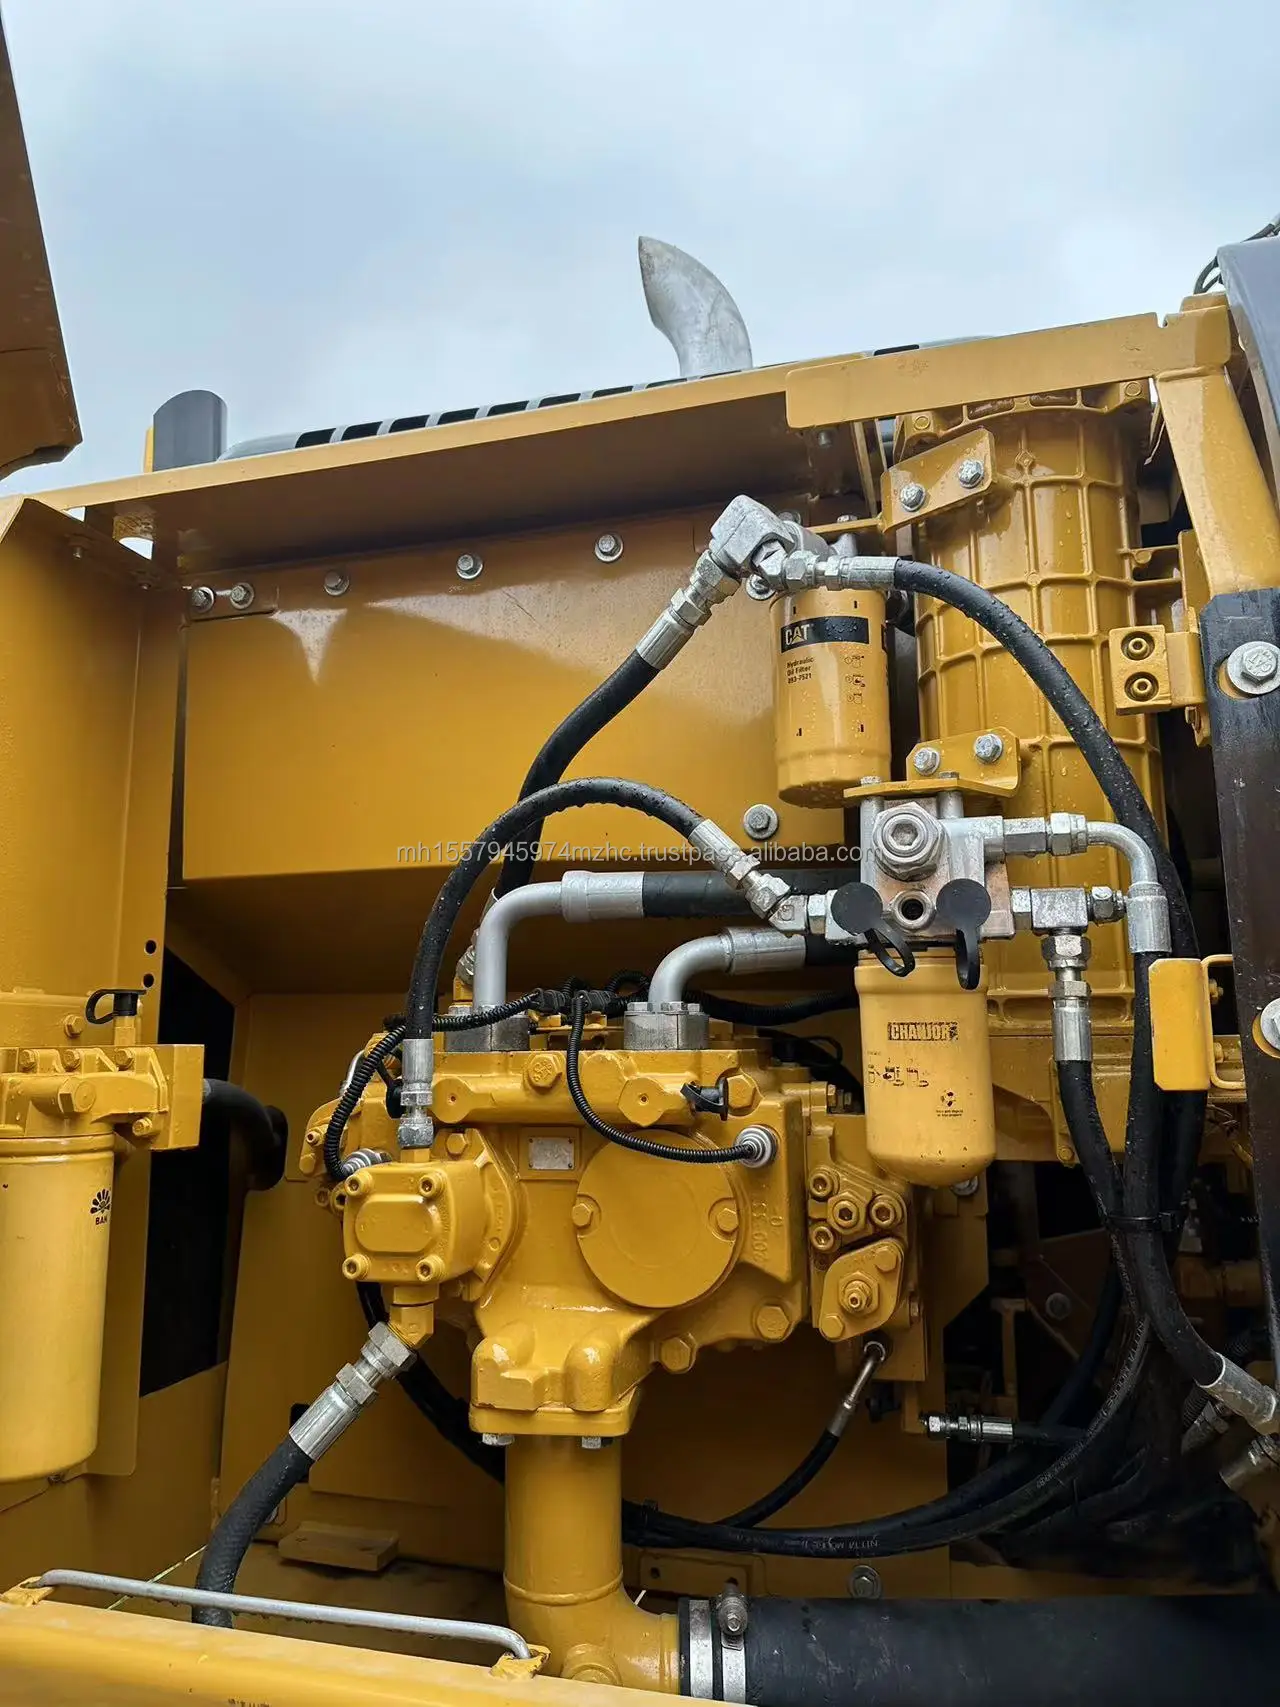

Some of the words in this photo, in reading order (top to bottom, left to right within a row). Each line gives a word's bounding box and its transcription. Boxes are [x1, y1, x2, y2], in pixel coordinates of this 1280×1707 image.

[785, 623, 810, 646] CAT
[786, 656, 814, 669] Hydraulic
[786, 668, 795, 677] Oil
[795, 666, 811, 674] Filter
